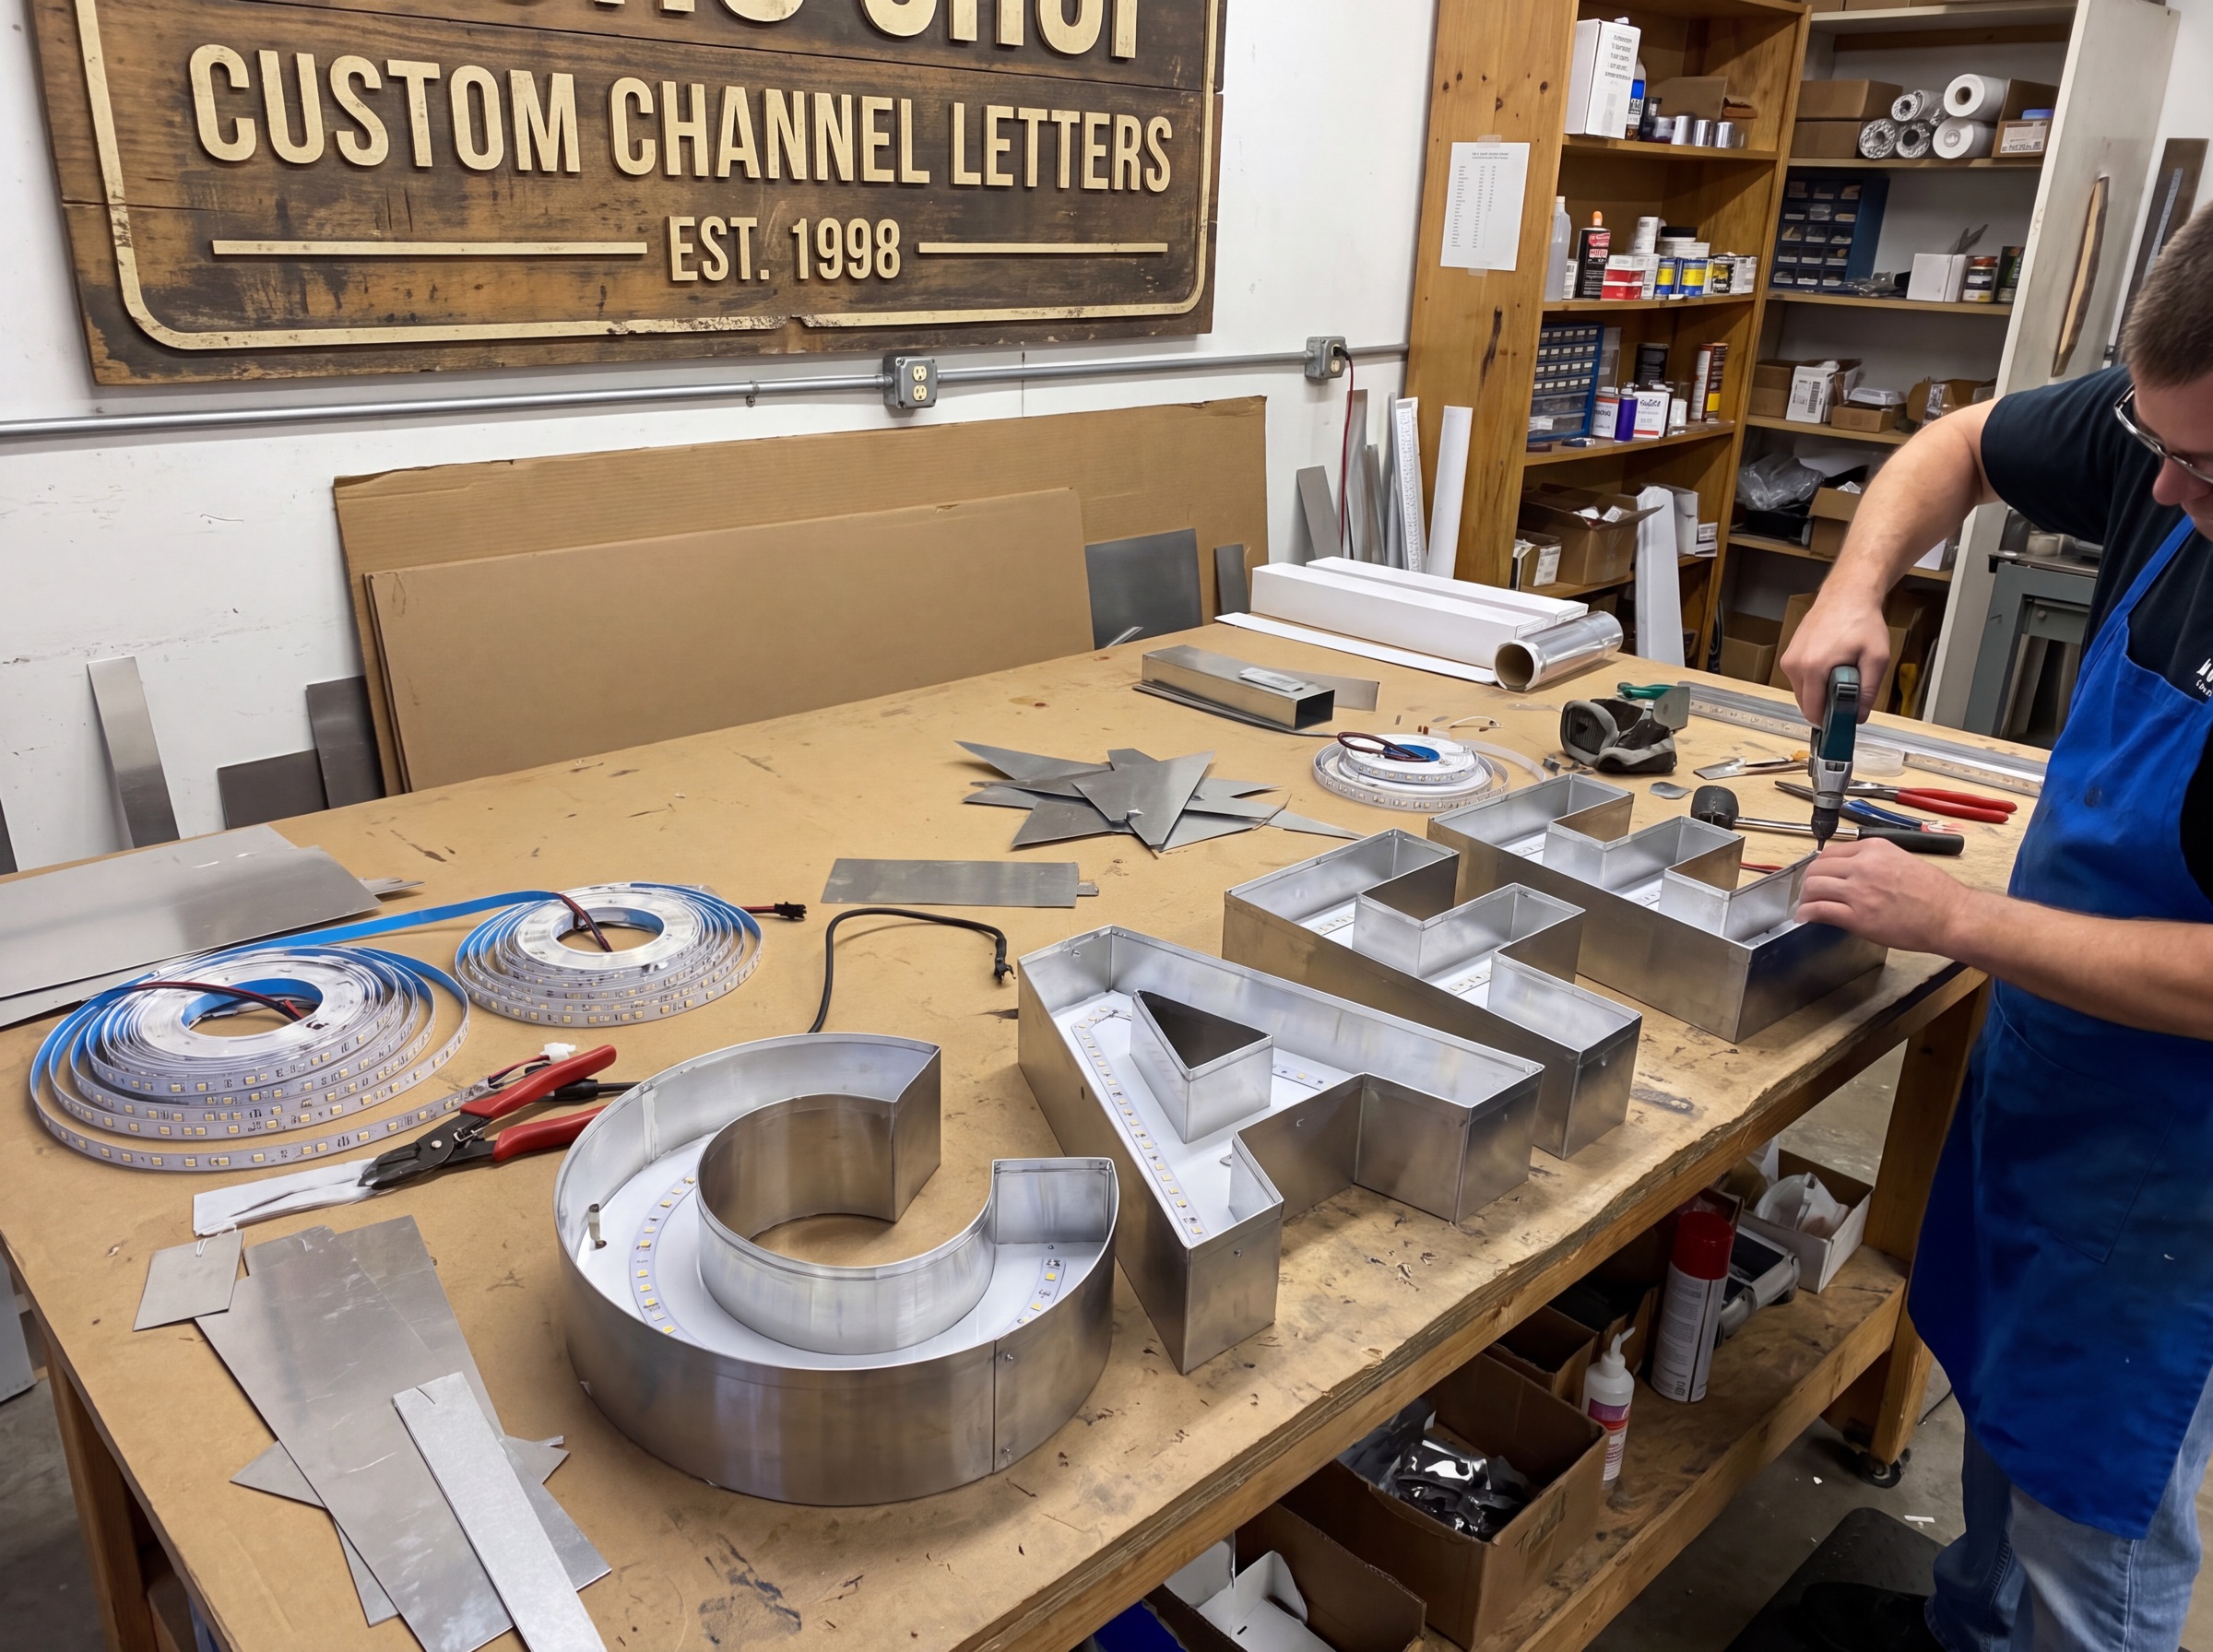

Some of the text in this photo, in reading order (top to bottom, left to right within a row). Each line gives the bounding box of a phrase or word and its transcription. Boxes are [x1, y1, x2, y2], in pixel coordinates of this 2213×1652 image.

[189, 44, 1173, 193] CUSTOM CHANNEL LETTERS
[667, 216, 901, 281] EST. 1998
